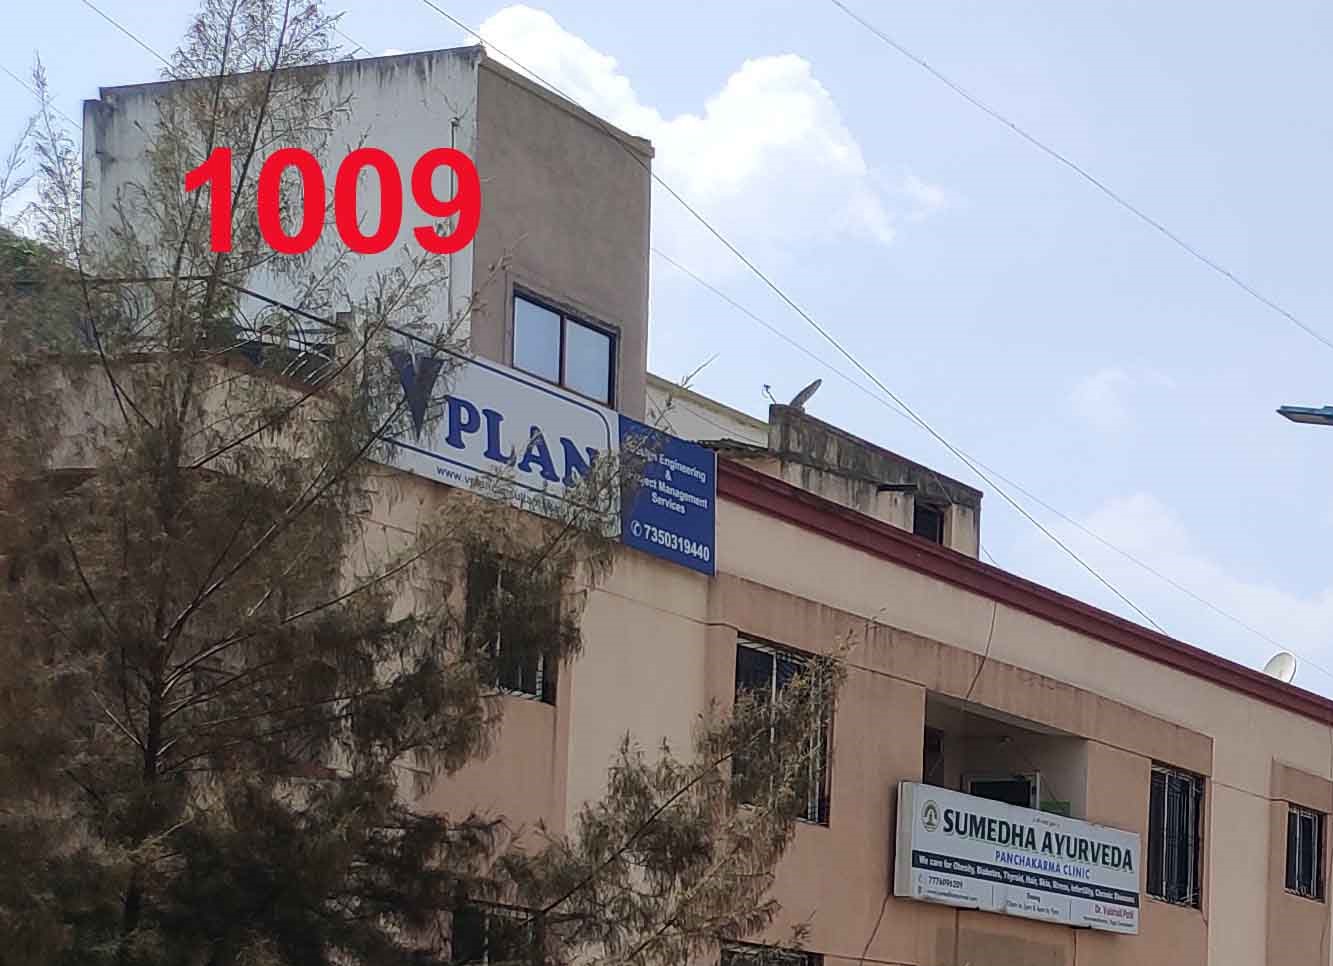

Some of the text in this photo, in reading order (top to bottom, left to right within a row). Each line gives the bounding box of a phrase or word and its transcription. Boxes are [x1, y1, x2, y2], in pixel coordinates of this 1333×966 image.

[444, 395, 600, 488] PLAN
[659, 454, 706, 482] Engineering
[651, 493, 686, 515] Services
[659, 482, 708, 510] Management
[643, 523, 711, 562] 7350319440
[943, 808, 1134, 871] SUMEDHA AYURVEDA
[995, 850, 1091, 880] PANCHAKARMA CLINIC
